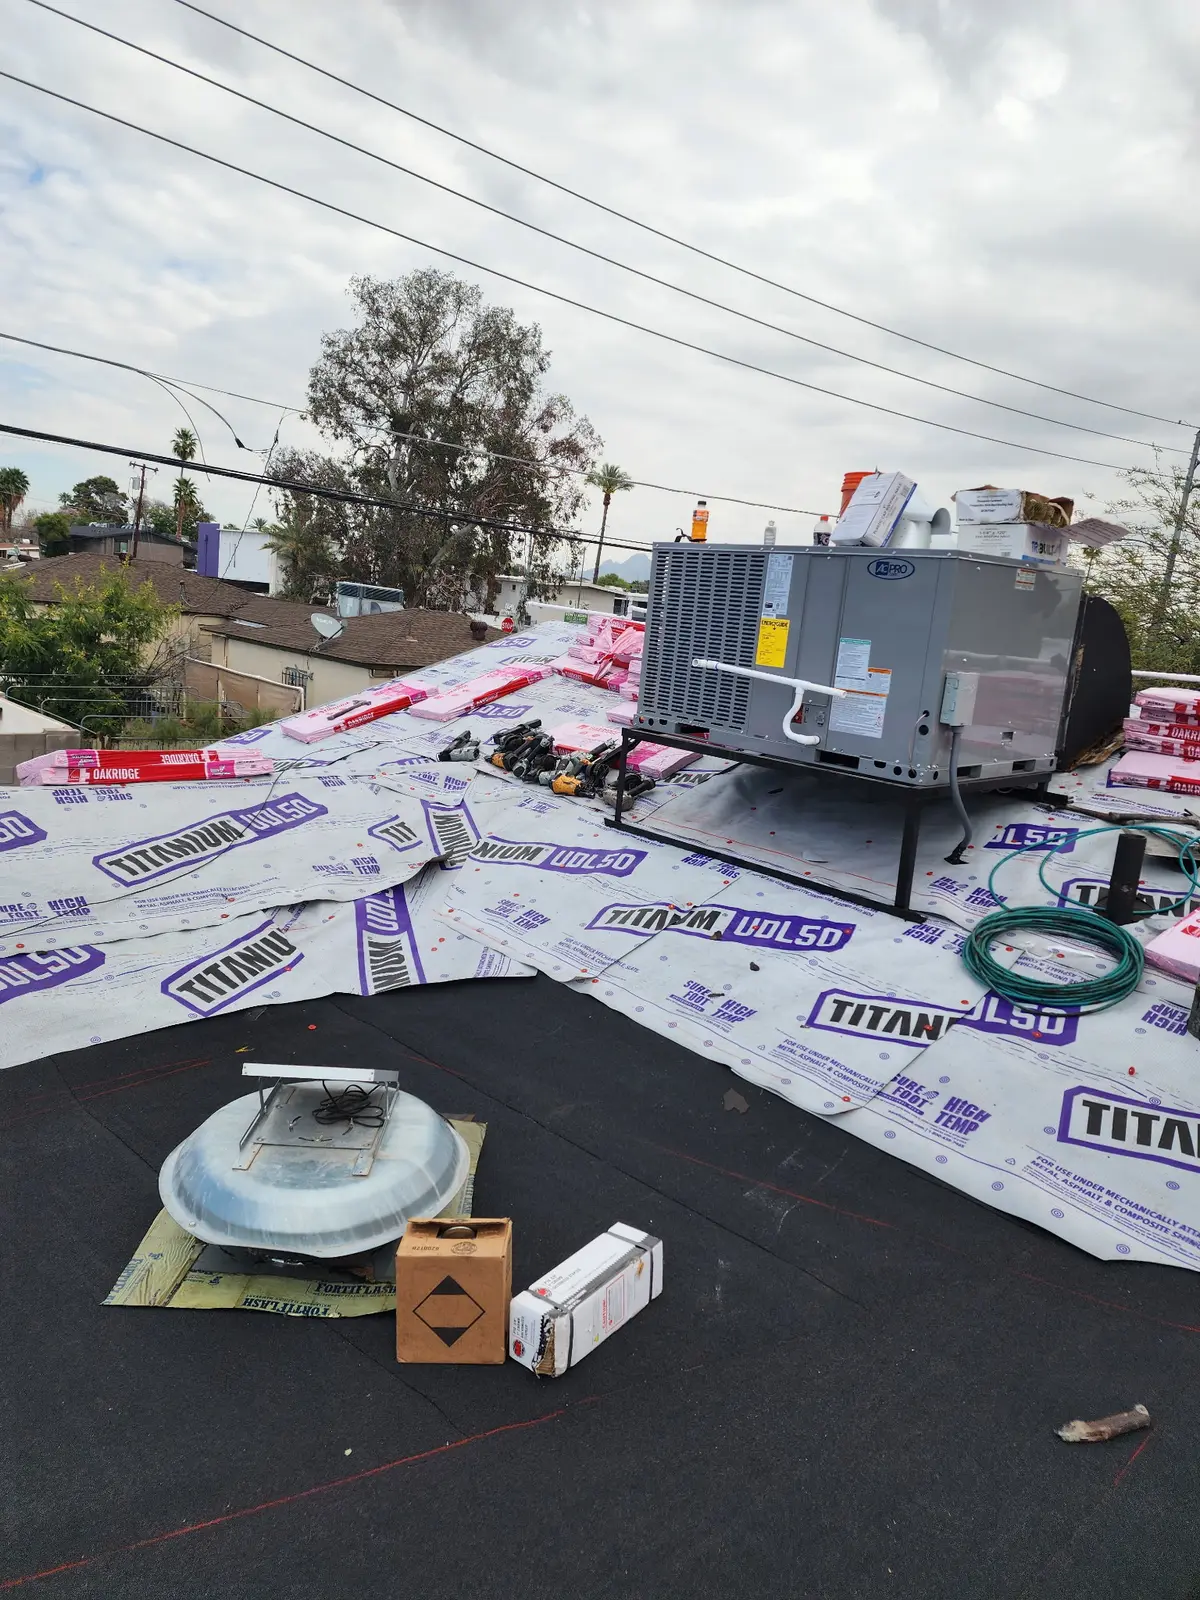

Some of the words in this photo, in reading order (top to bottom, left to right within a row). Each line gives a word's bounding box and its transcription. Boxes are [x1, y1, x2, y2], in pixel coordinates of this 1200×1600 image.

[889, 564, 907, 574] PRO
[502, 622, 513, 630] STOP
[93, 768, 140, 780] OAKRIDGE
[445, 775, 468, 787] HIGH
[52, 788, 84, 796] TEMP
[55, 795, 89, 805] HIGH
[108, 819, 246, 876] TITANIUM
[239, 800, 318, 831] UDL50
[351, 856, 378, 865] HIGH
[550, 850, 636, 870] UDL50
[682, 856, 709, 868] HIGH
[356, 865, 381, 875] TEMP
[716, 867, 741, 880] SURE
[0, 903, 25, 913] URE
[47, 896, 88, 911] HIGH
[965, 894, 998, 908] TEMP
[8, 910, 39, 919] FOOT
[513, 915, 539, 930] TEMP
[523, 909, 551, 925] HIGH
[732, 917, 842, 947] UDL50
[902, 928, 938, 945] HIGH
[368, 939, 411, 993] NIUM
[683, 980, 711, 996] SURE
[683, 990, 711, 1006] FOOT
[711, 1009, 745, 1023] TEMP
[721, 999, 758, 1018] HIGH
[1141, 1009, 1188, 1037] HIGH
[777, 1043, 798, 1058] METAL,
[798, 1053, 827, 1070] ASPHALT,
[832, 1069, 873, 1094] COMPOSITE
[783, 1038, 796, 1048] FOR
[794, 1043, 808, 1054] USE
[808, 1048, 831, 1063] UNDER
[829, 1057, 880, 1088] MECHANICALLY
[890, 1073, 926, 1094] SURE
[891, 1086, 929, 1108] FOOT
[942, 1096, 991, 1123] HIGH
[934, 1110, 980, 1136] TEMP
[1030, 1160, 1060, 1180] METAL,
[1062, 1178, 1102, 1204] ASPHALT,
[1104, 1199, 1113, 1207] &
[1114, 1204, 1170, 1235] COMPOSITE
[1036, 1155, 1054, 1168] FOR
[1055, 1165, 1072, 1178] USE
[1072, 1174, 1105, 1193] UNDER
[1105, 1189, 1179, 1228] MECHANICALLY
[315, 1282, 396, 1296] FORTIFLASH
